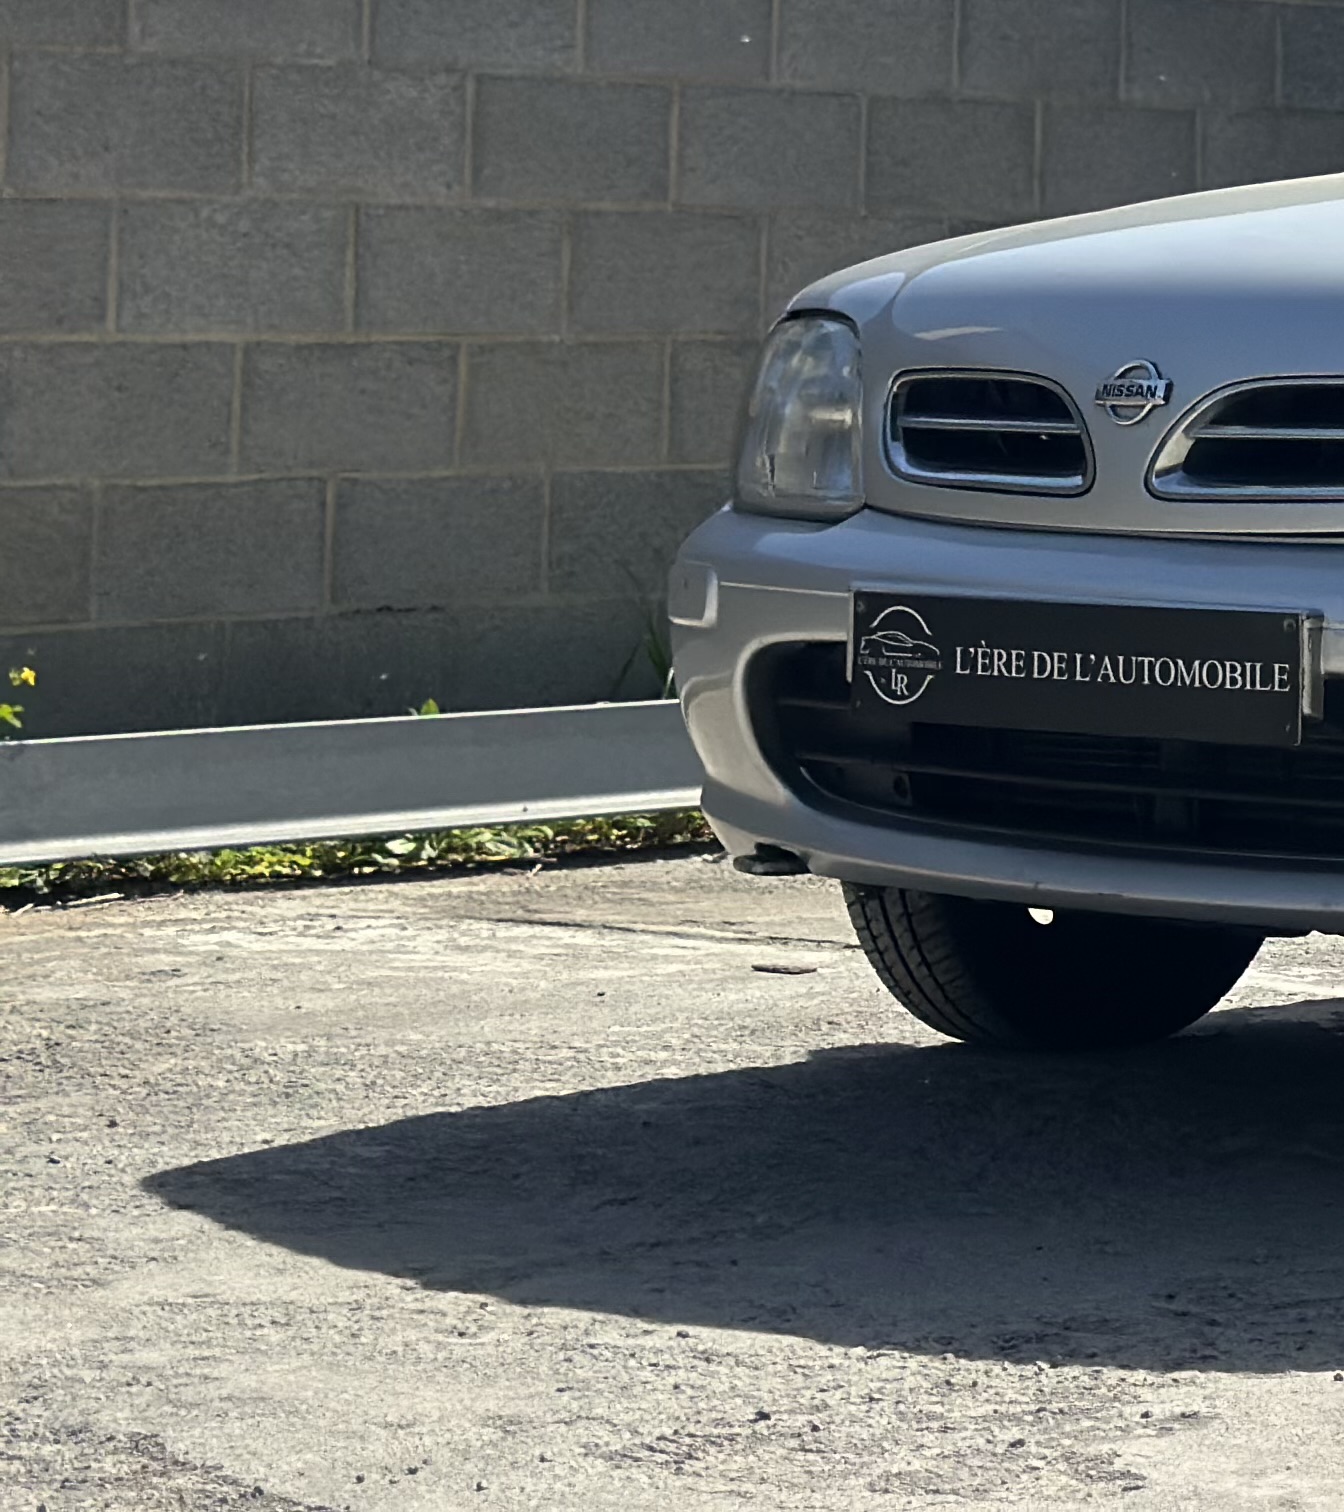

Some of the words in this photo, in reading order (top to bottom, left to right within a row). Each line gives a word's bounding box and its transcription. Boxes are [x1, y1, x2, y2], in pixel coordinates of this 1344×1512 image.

[1101, 384, 1157, 399] NISSAN
[955, 639, 1026, 678] L'ÈRE
[1031, 651, 1069, 681] DE
[1074, 652, 1291, 692] L'AUTOMOBILE
